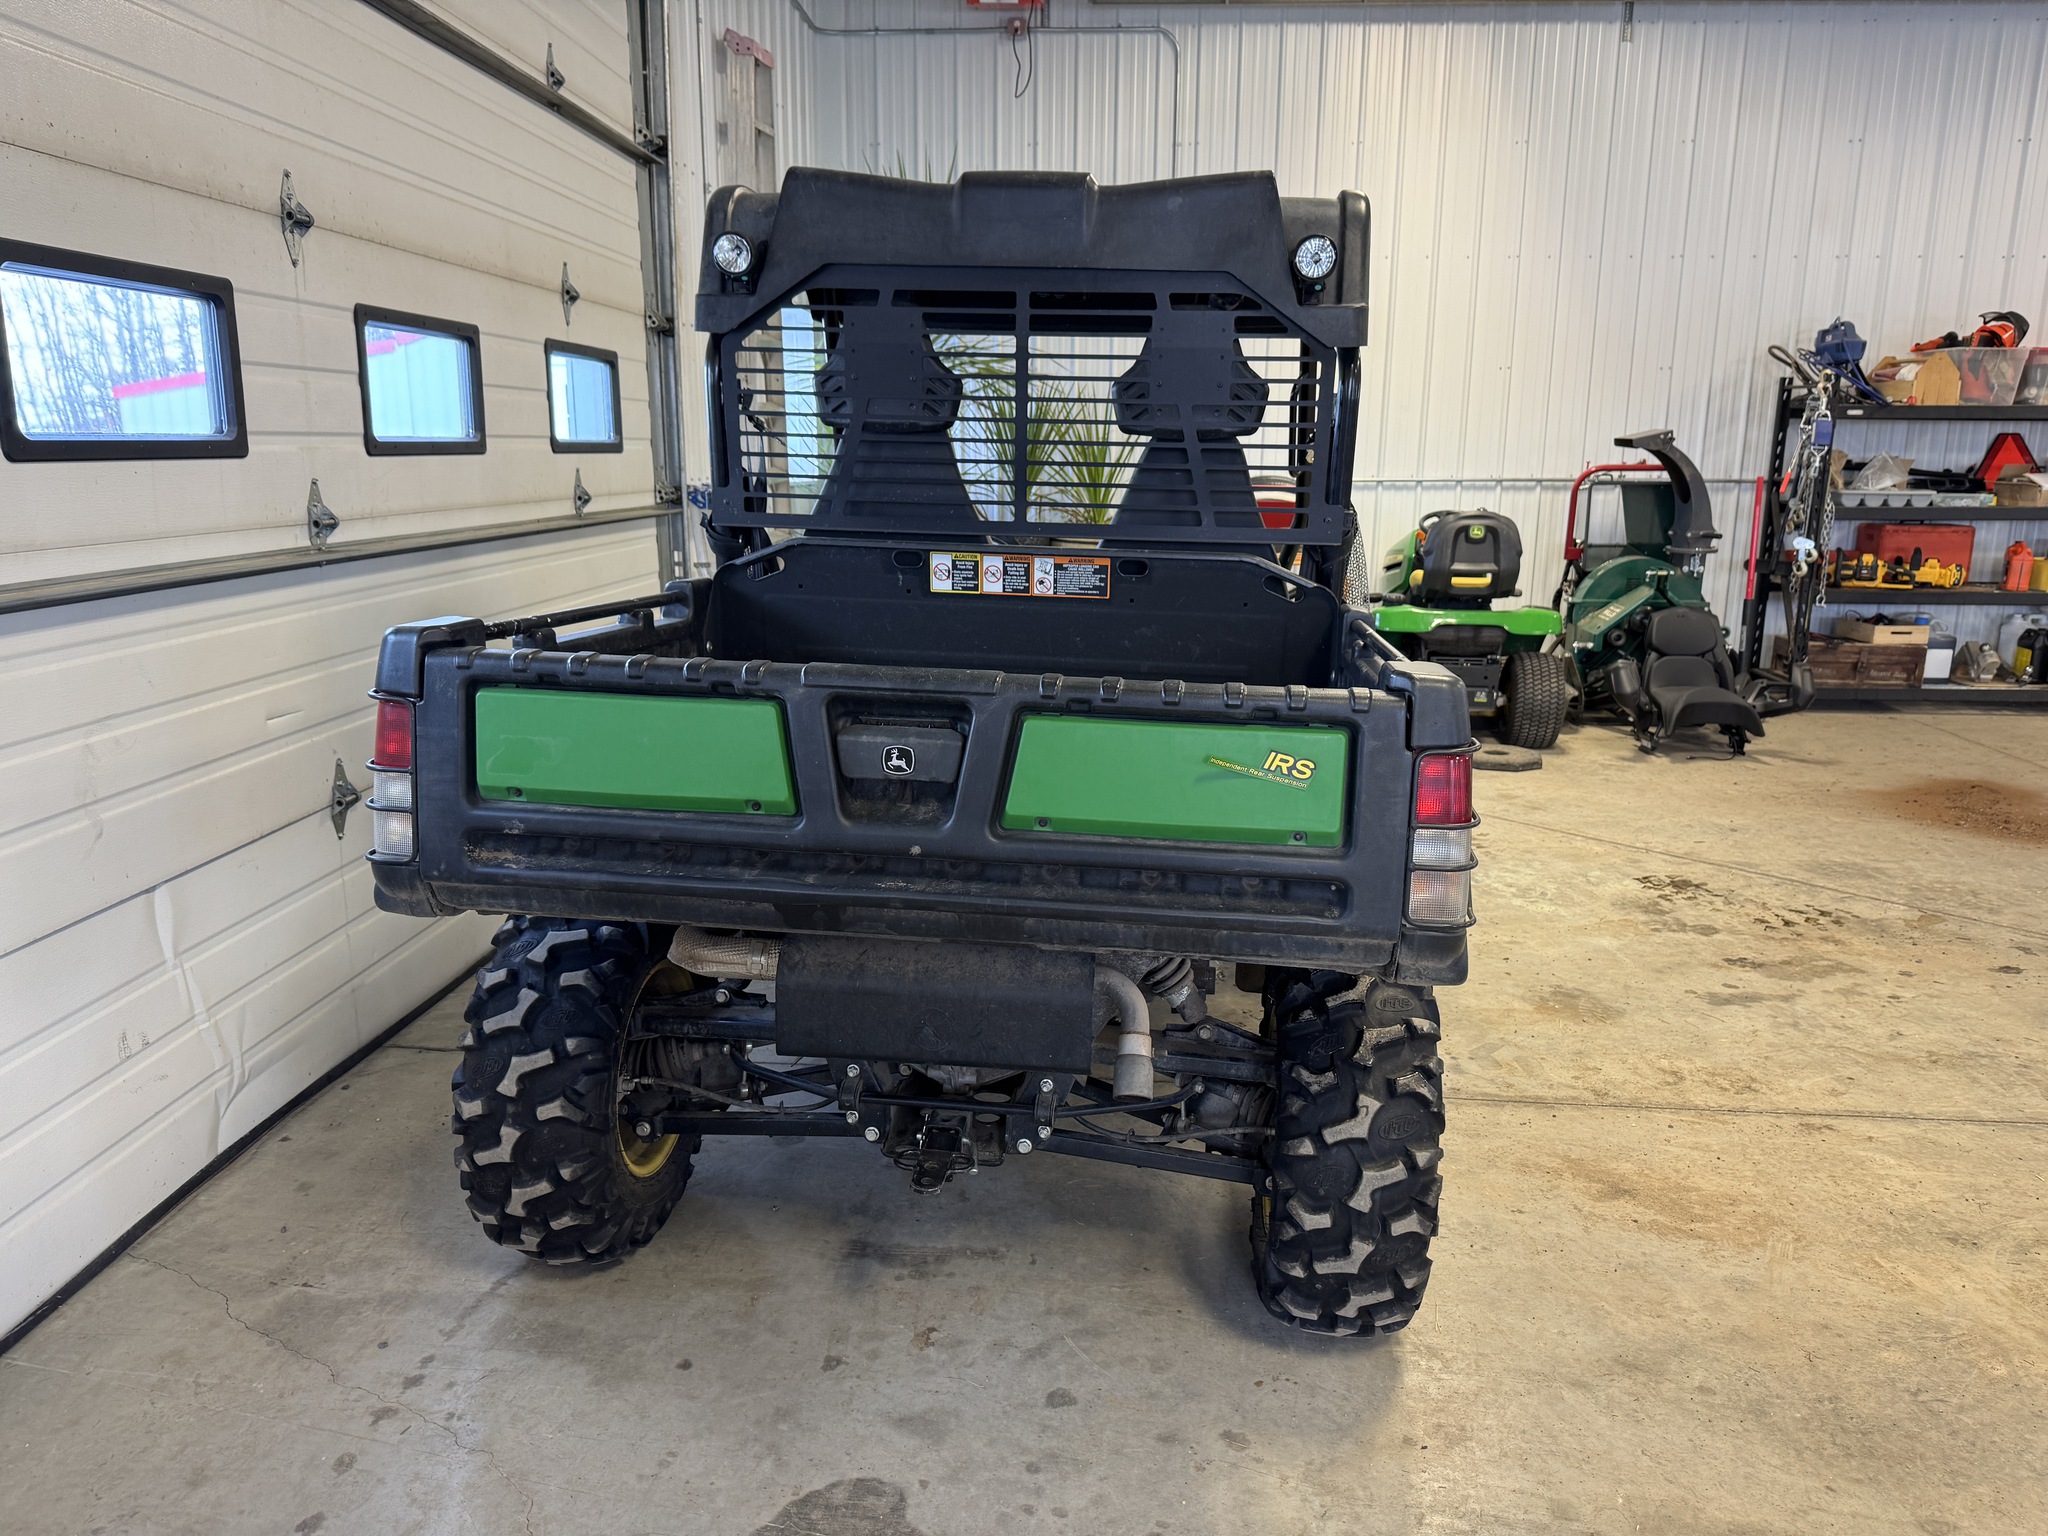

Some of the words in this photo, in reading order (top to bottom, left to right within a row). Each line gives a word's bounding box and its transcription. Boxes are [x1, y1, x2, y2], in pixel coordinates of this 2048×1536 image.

[1210, 757, 1248, 773] Independent
[1249, 768, 1265, 777] Rear
[1266, 773, 1307, 788] Suspension
[1263, 751, 1316, 780] IRS
